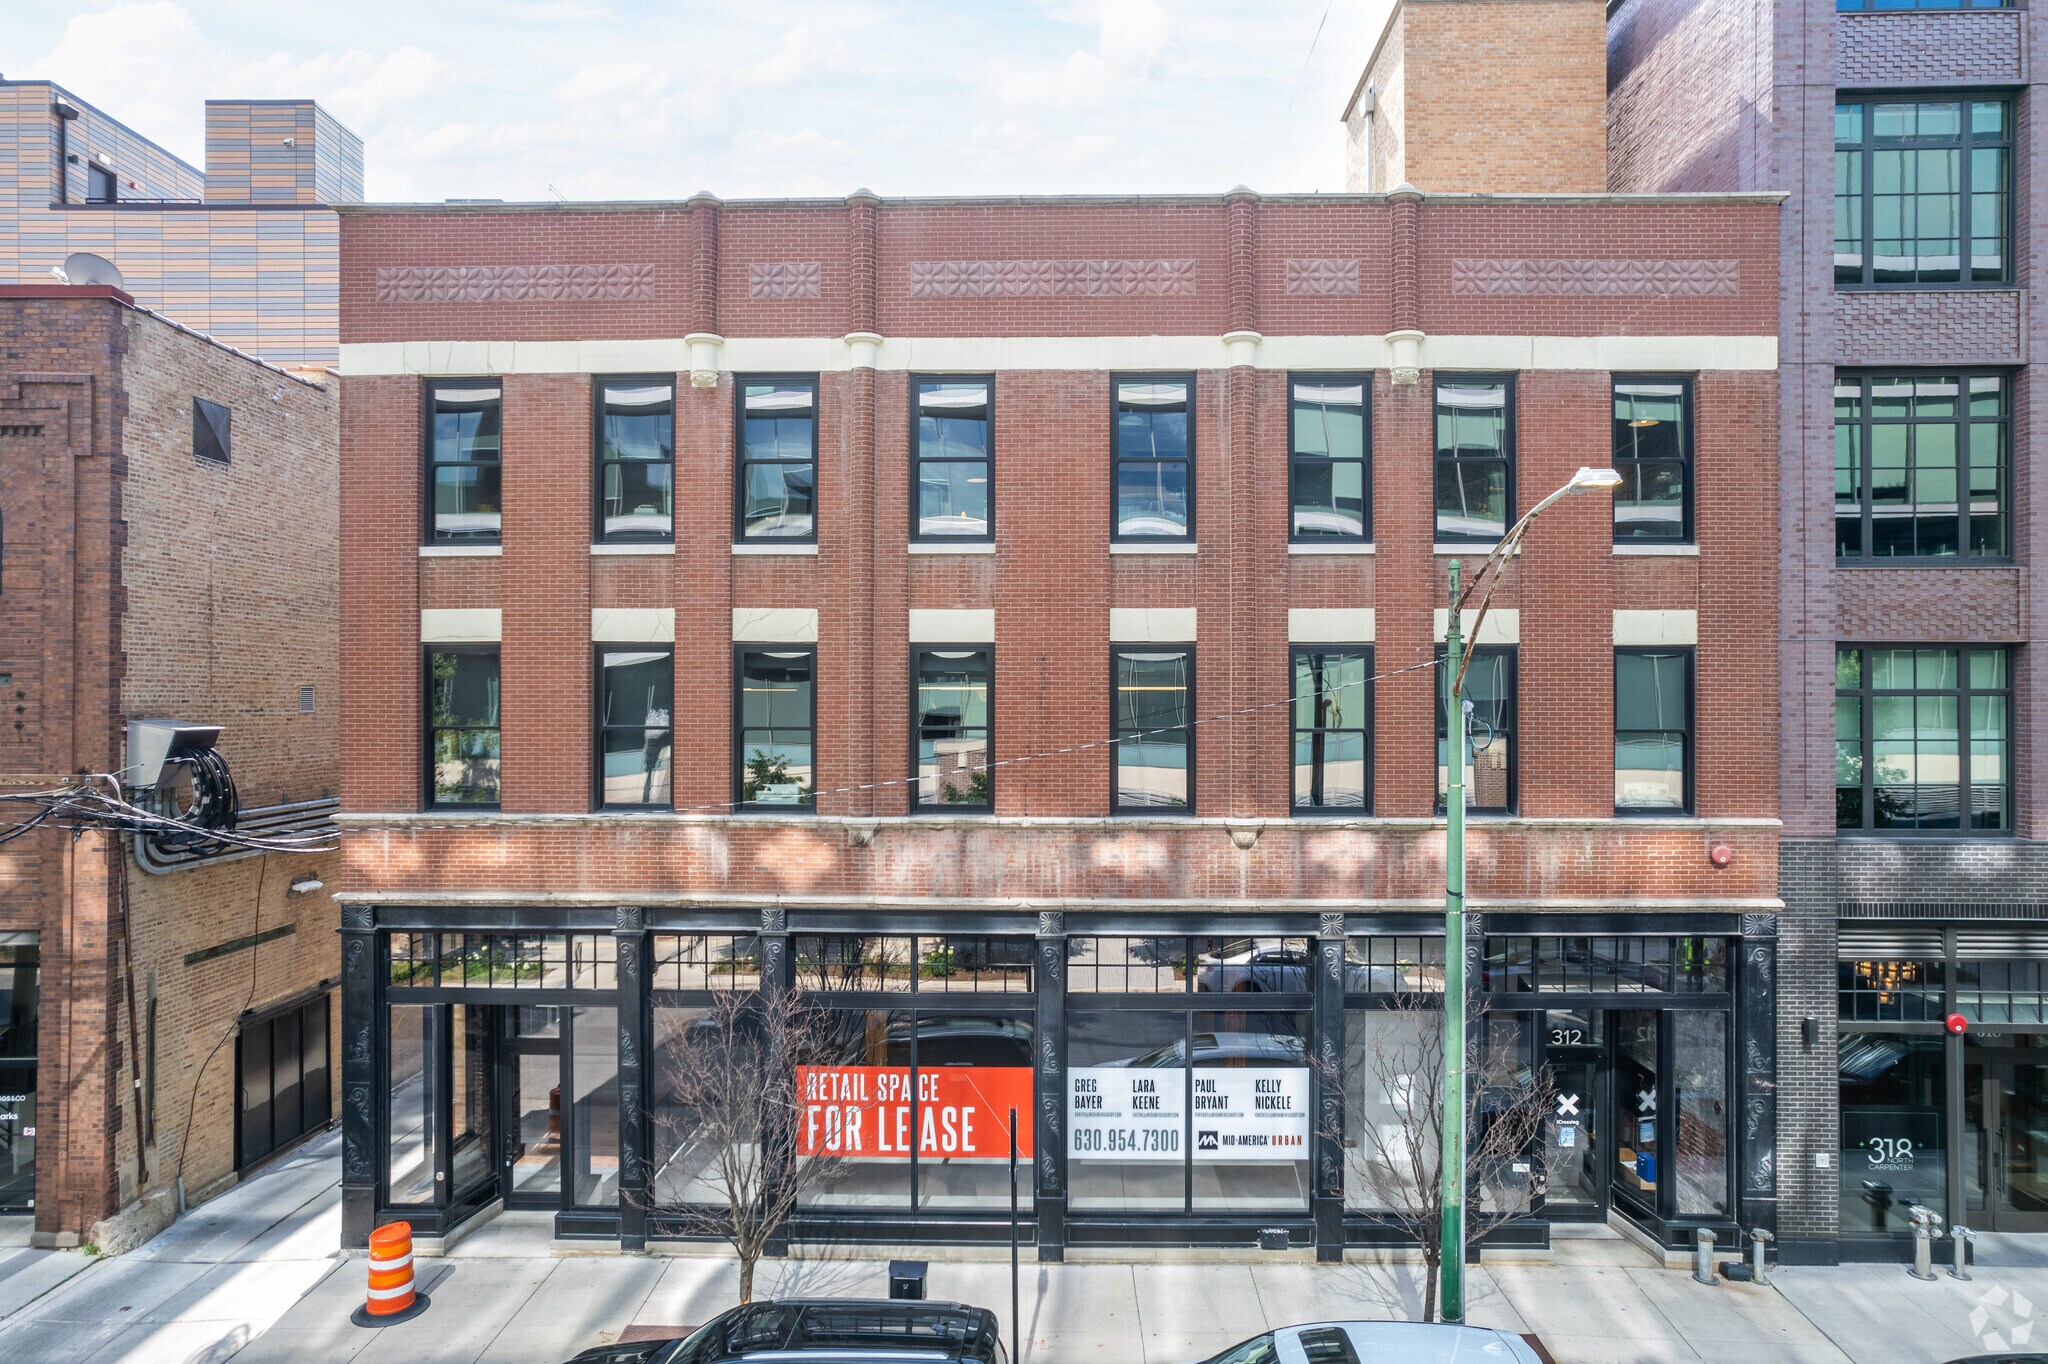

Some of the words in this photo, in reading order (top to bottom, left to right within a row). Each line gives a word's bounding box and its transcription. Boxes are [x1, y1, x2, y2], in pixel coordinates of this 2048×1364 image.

[1552, 1029, 1582, 1045] 312
[807, 1072, 868, 1101] RETAIL
[877, 1073, 940, 1102] SPACE
[1074, 1078, 1098, 1093] GREG
[1132, 1079, 1155, 1093] LARA
[1195, 1079, 1216, 1093] PAUL
[1255, 1079, 1282, 1093] KELLY
[1074, 1095, 1103, 1109] BAYER
[1132, 1095, 1160, 1110] KEENE
[1195, 1095, 1229, 1110] BRYANT
[1255, 1095, 1292, 1110] NICKELE
[807, 1105, 862, 1151] FOR
[878, 1106, 976, 1152] LEASE
[1074, 1128, 1179, 1152] 630.954.7300
[1271, 1134, 1302, 1146] URBAN
[1868, 1137, 1914, 1164] 318
[1868, 1163, 1914, 1171] CARPENTER
